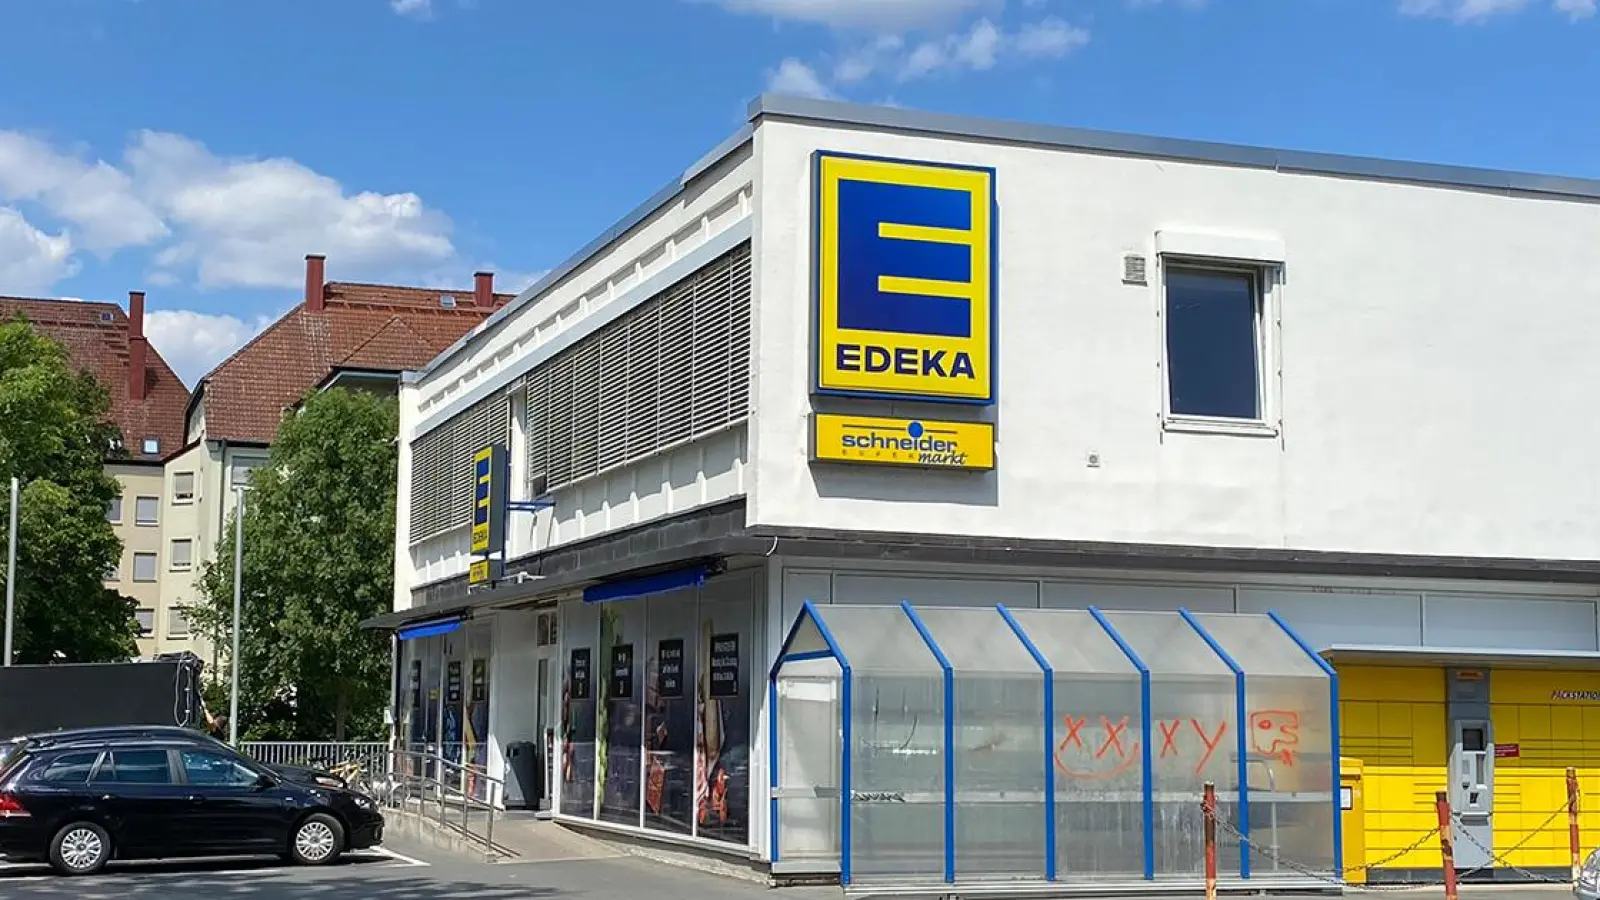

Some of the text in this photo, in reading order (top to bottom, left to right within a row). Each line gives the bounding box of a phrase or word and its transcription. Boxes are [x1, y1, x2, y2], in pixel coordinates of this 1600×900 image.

[836, 343, 976, 379] EDEKA
[842, 430, 958, 452] schneider
[918, 449, 968, 465] markt
